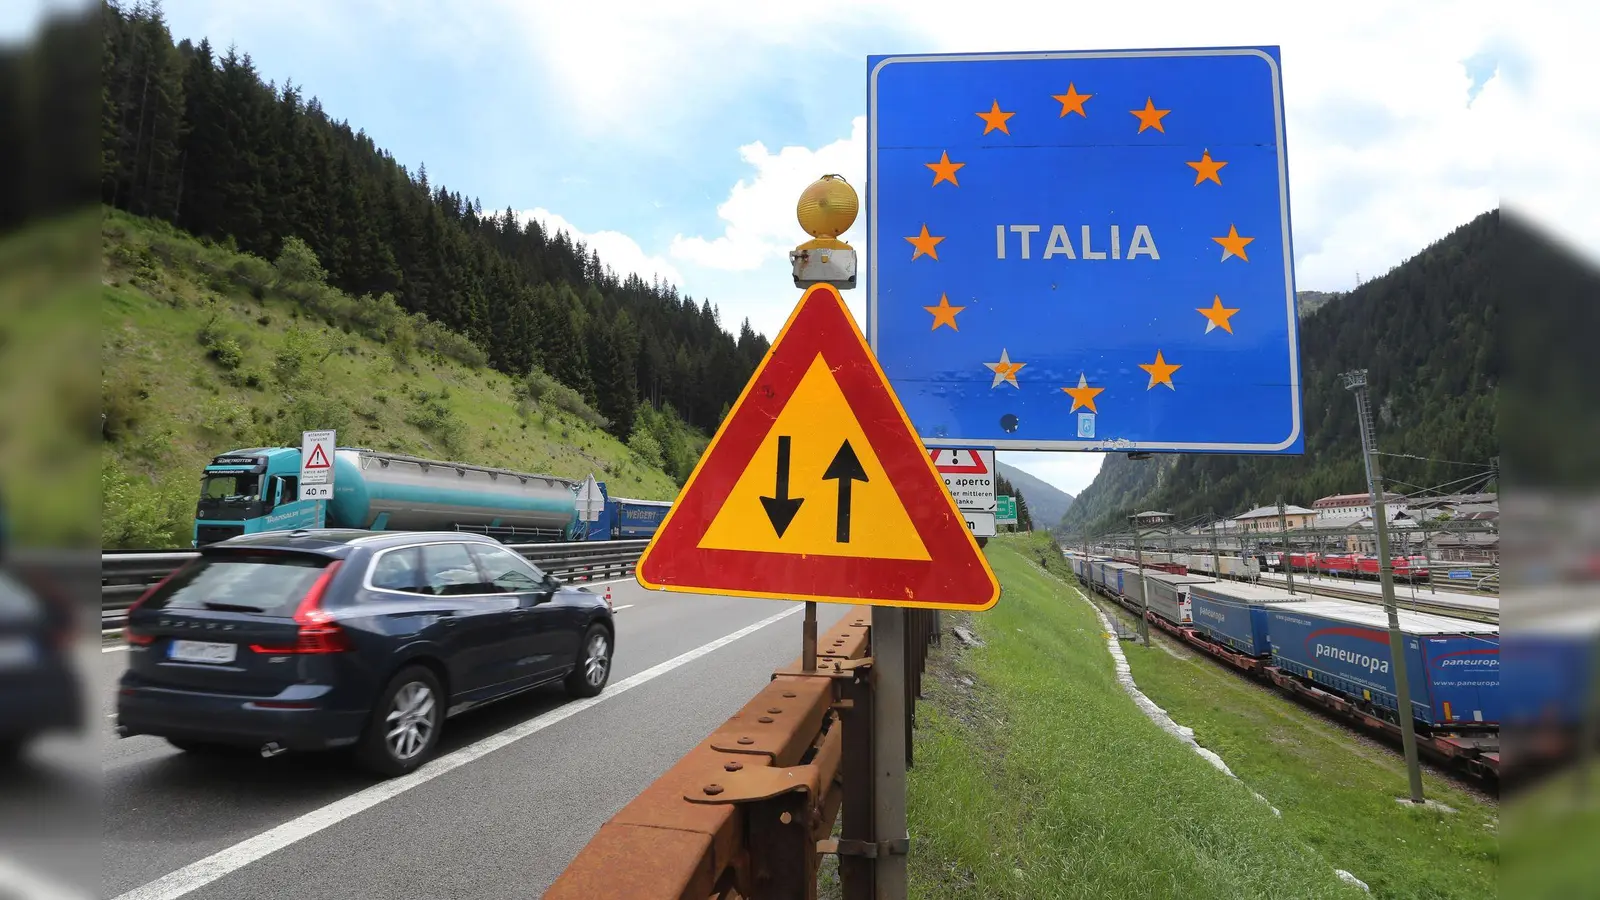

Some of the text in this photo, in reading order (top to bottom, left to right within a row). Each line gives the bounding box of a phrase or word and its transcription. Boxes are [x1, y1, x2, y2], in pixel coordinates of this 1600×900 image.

[996, 224, 1161, 260] ITALIA
[305, 488, 317, 496] 40
[1199, 606, 1225, 623] paneuropa
[1315, 643, 1389, 674] paneuropa
[1441, 658, 1500, 668] paneurop
